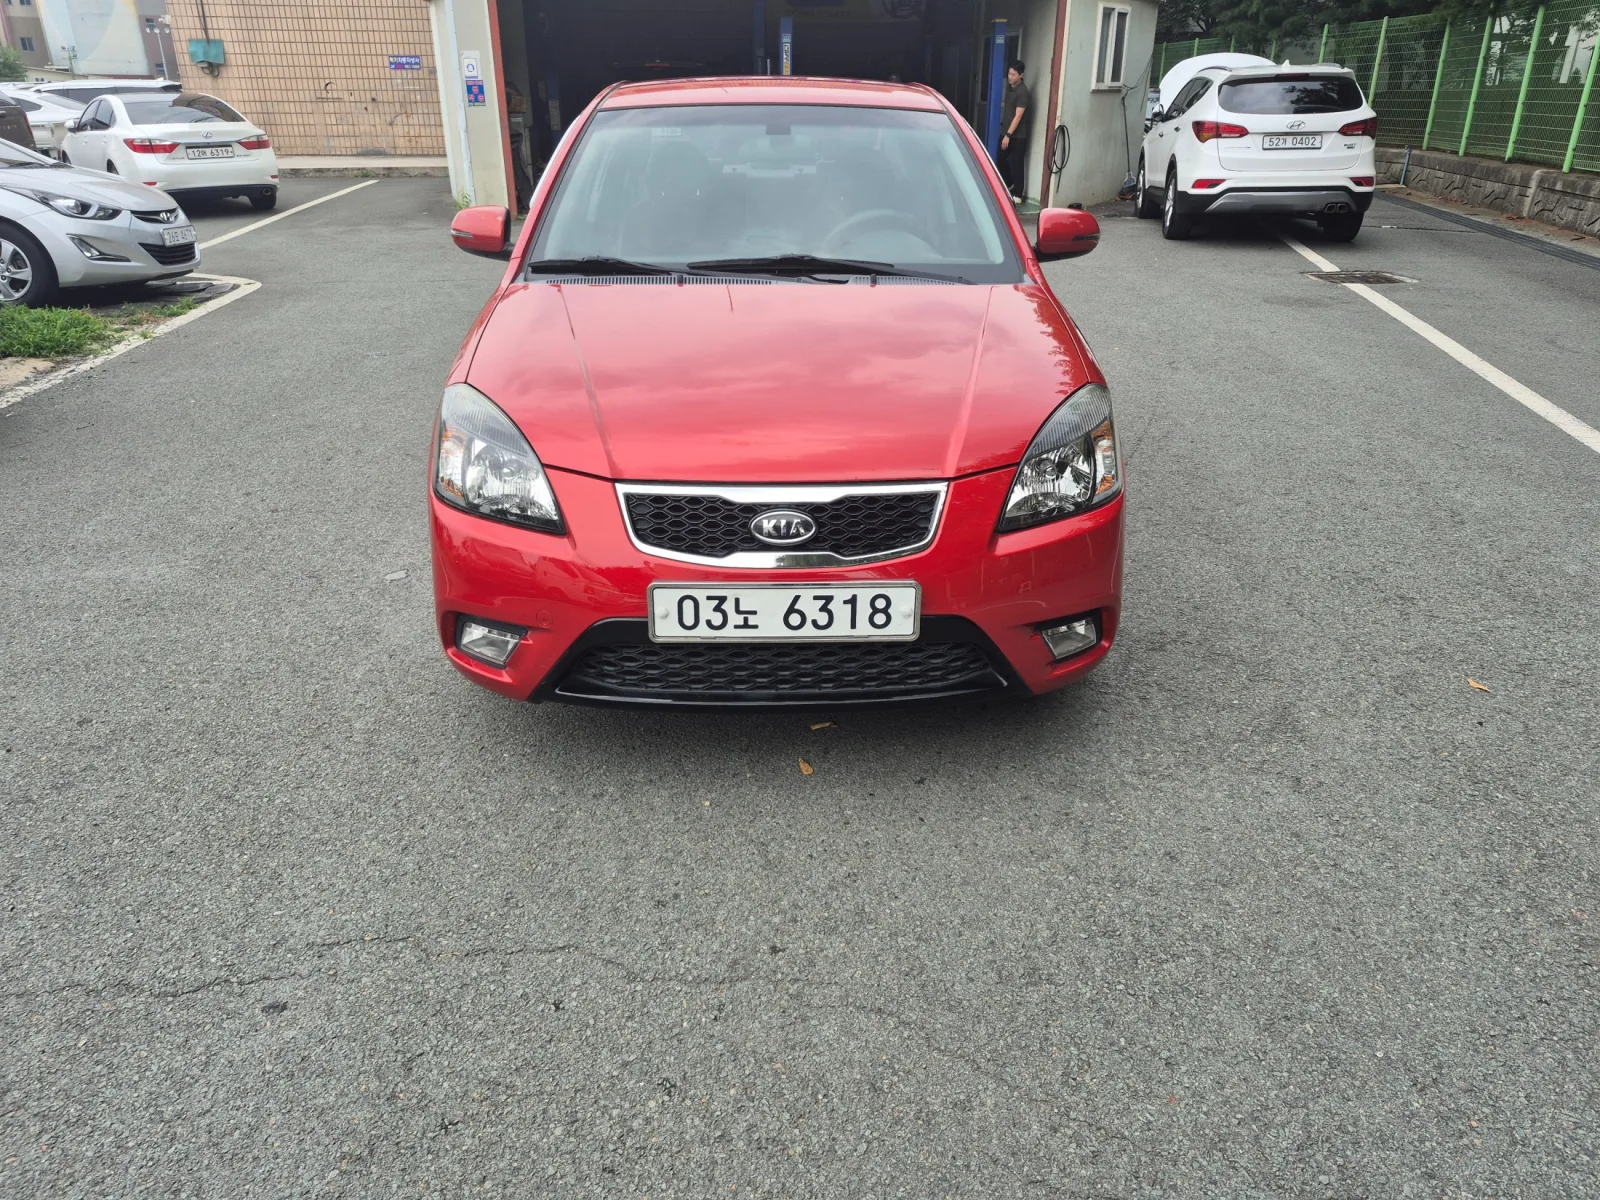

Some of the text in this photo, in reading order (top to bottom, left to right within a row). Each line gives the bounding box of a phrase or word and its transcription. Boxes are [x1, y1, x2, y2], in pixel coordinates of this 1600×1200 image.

[1268, 136, 1317, 147] 52가 0402
[209, 148, 230, 158] 6319
[761, 518, 807, 537] KIA
[677, 593, 893, 632] 03노 6318
